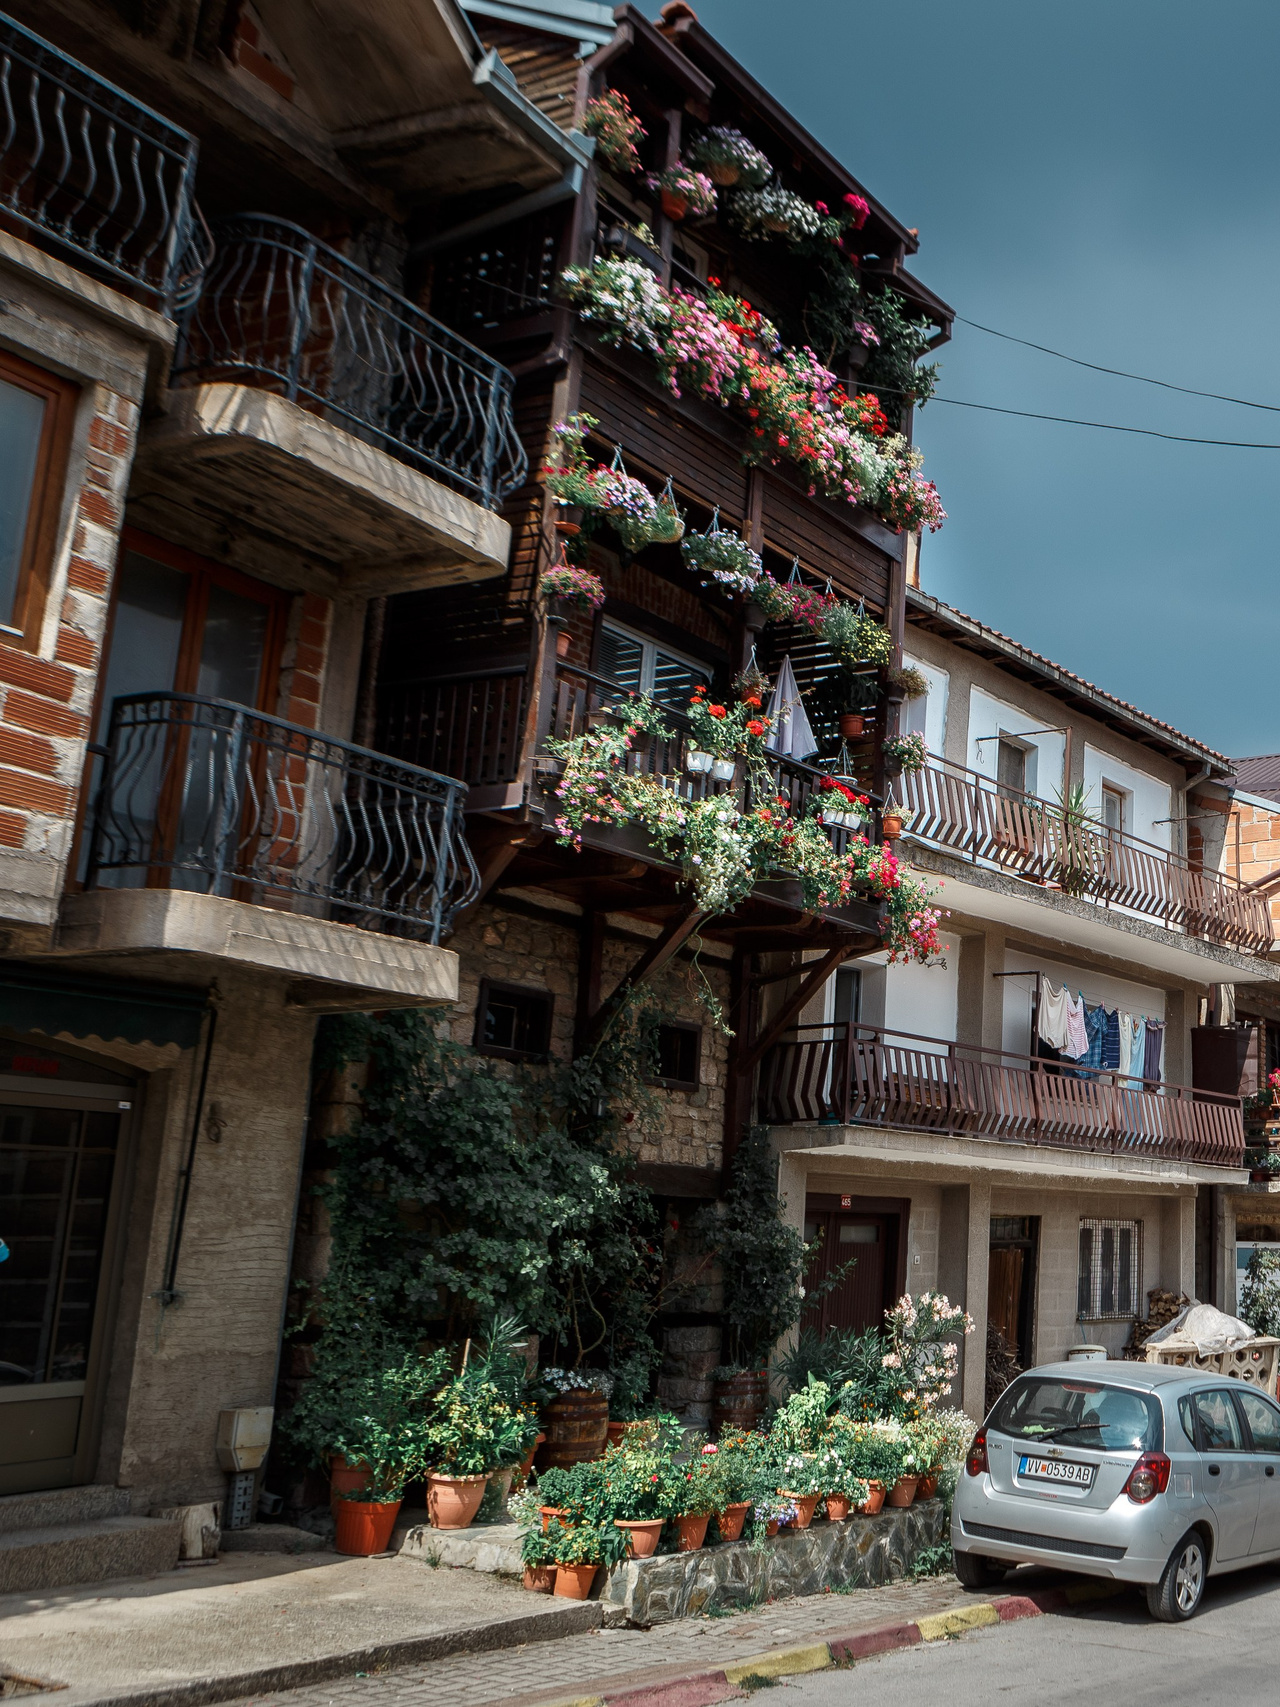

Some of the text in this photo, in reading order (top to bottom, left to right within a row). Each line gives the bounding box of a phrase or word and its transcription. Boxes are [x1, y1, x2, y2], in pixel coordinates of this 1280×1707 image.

[1028, 1459, 1091, 1482] VV 0539 AB
